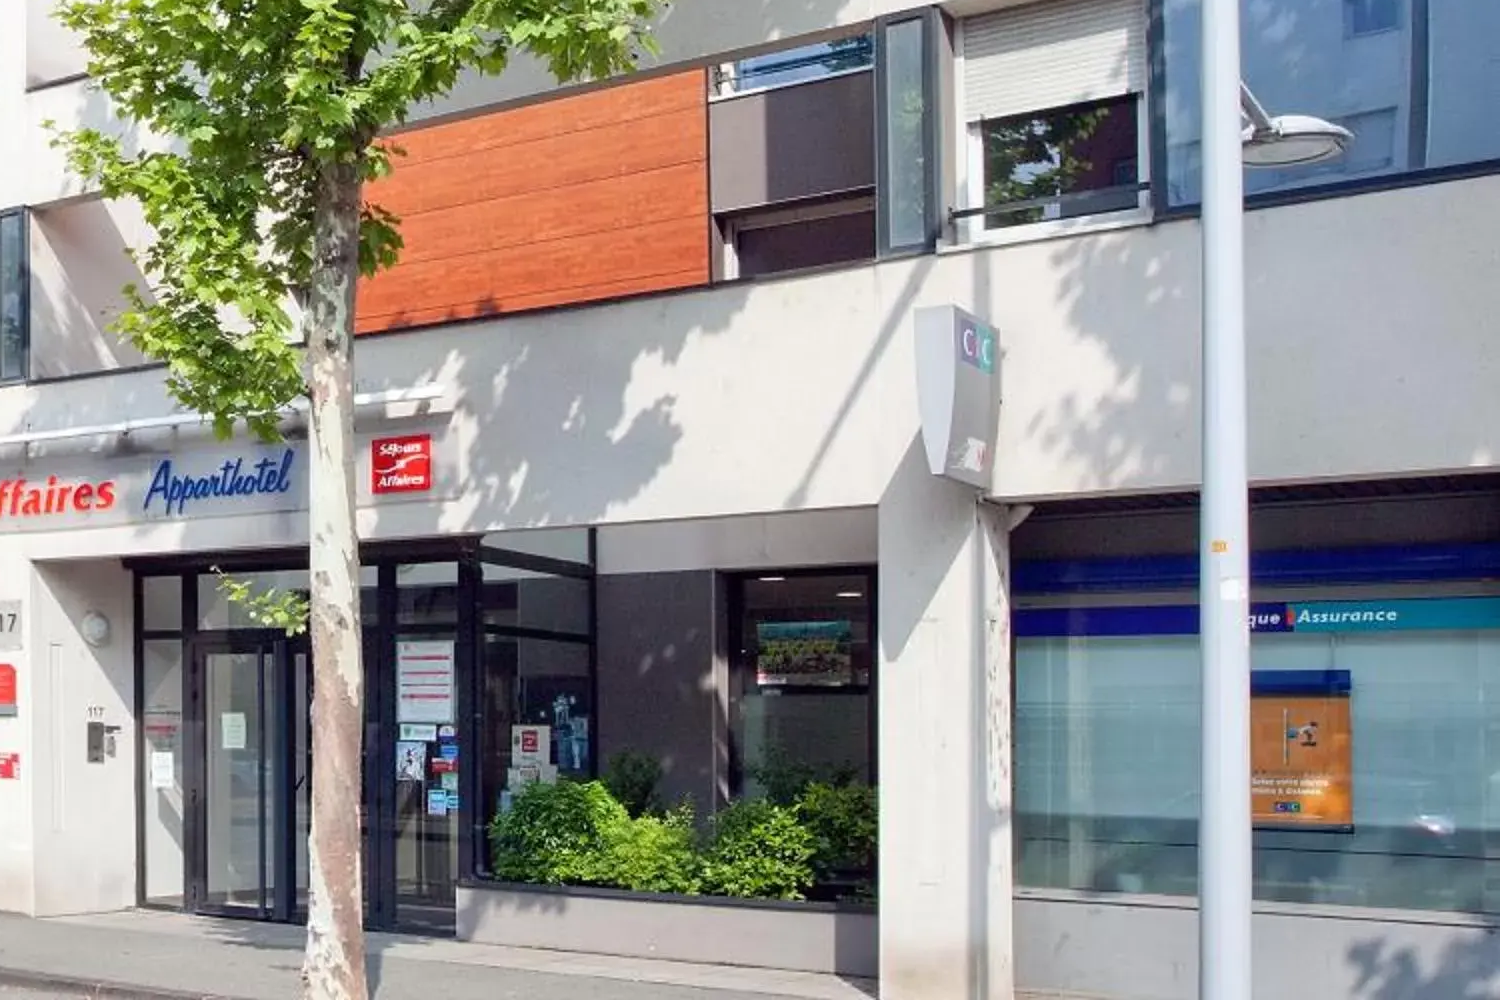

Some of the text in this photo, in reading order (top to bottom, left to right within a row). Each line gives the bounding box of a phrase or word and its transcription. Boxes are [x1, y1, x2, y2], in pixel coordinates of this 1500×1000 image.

[380, 442, 422, 457] Séjours
[143, 448, 295, 516] Apparthotel
[378, 474, 425, 489] Affaires
[1246, 608, 1398, 629] que Assurance
